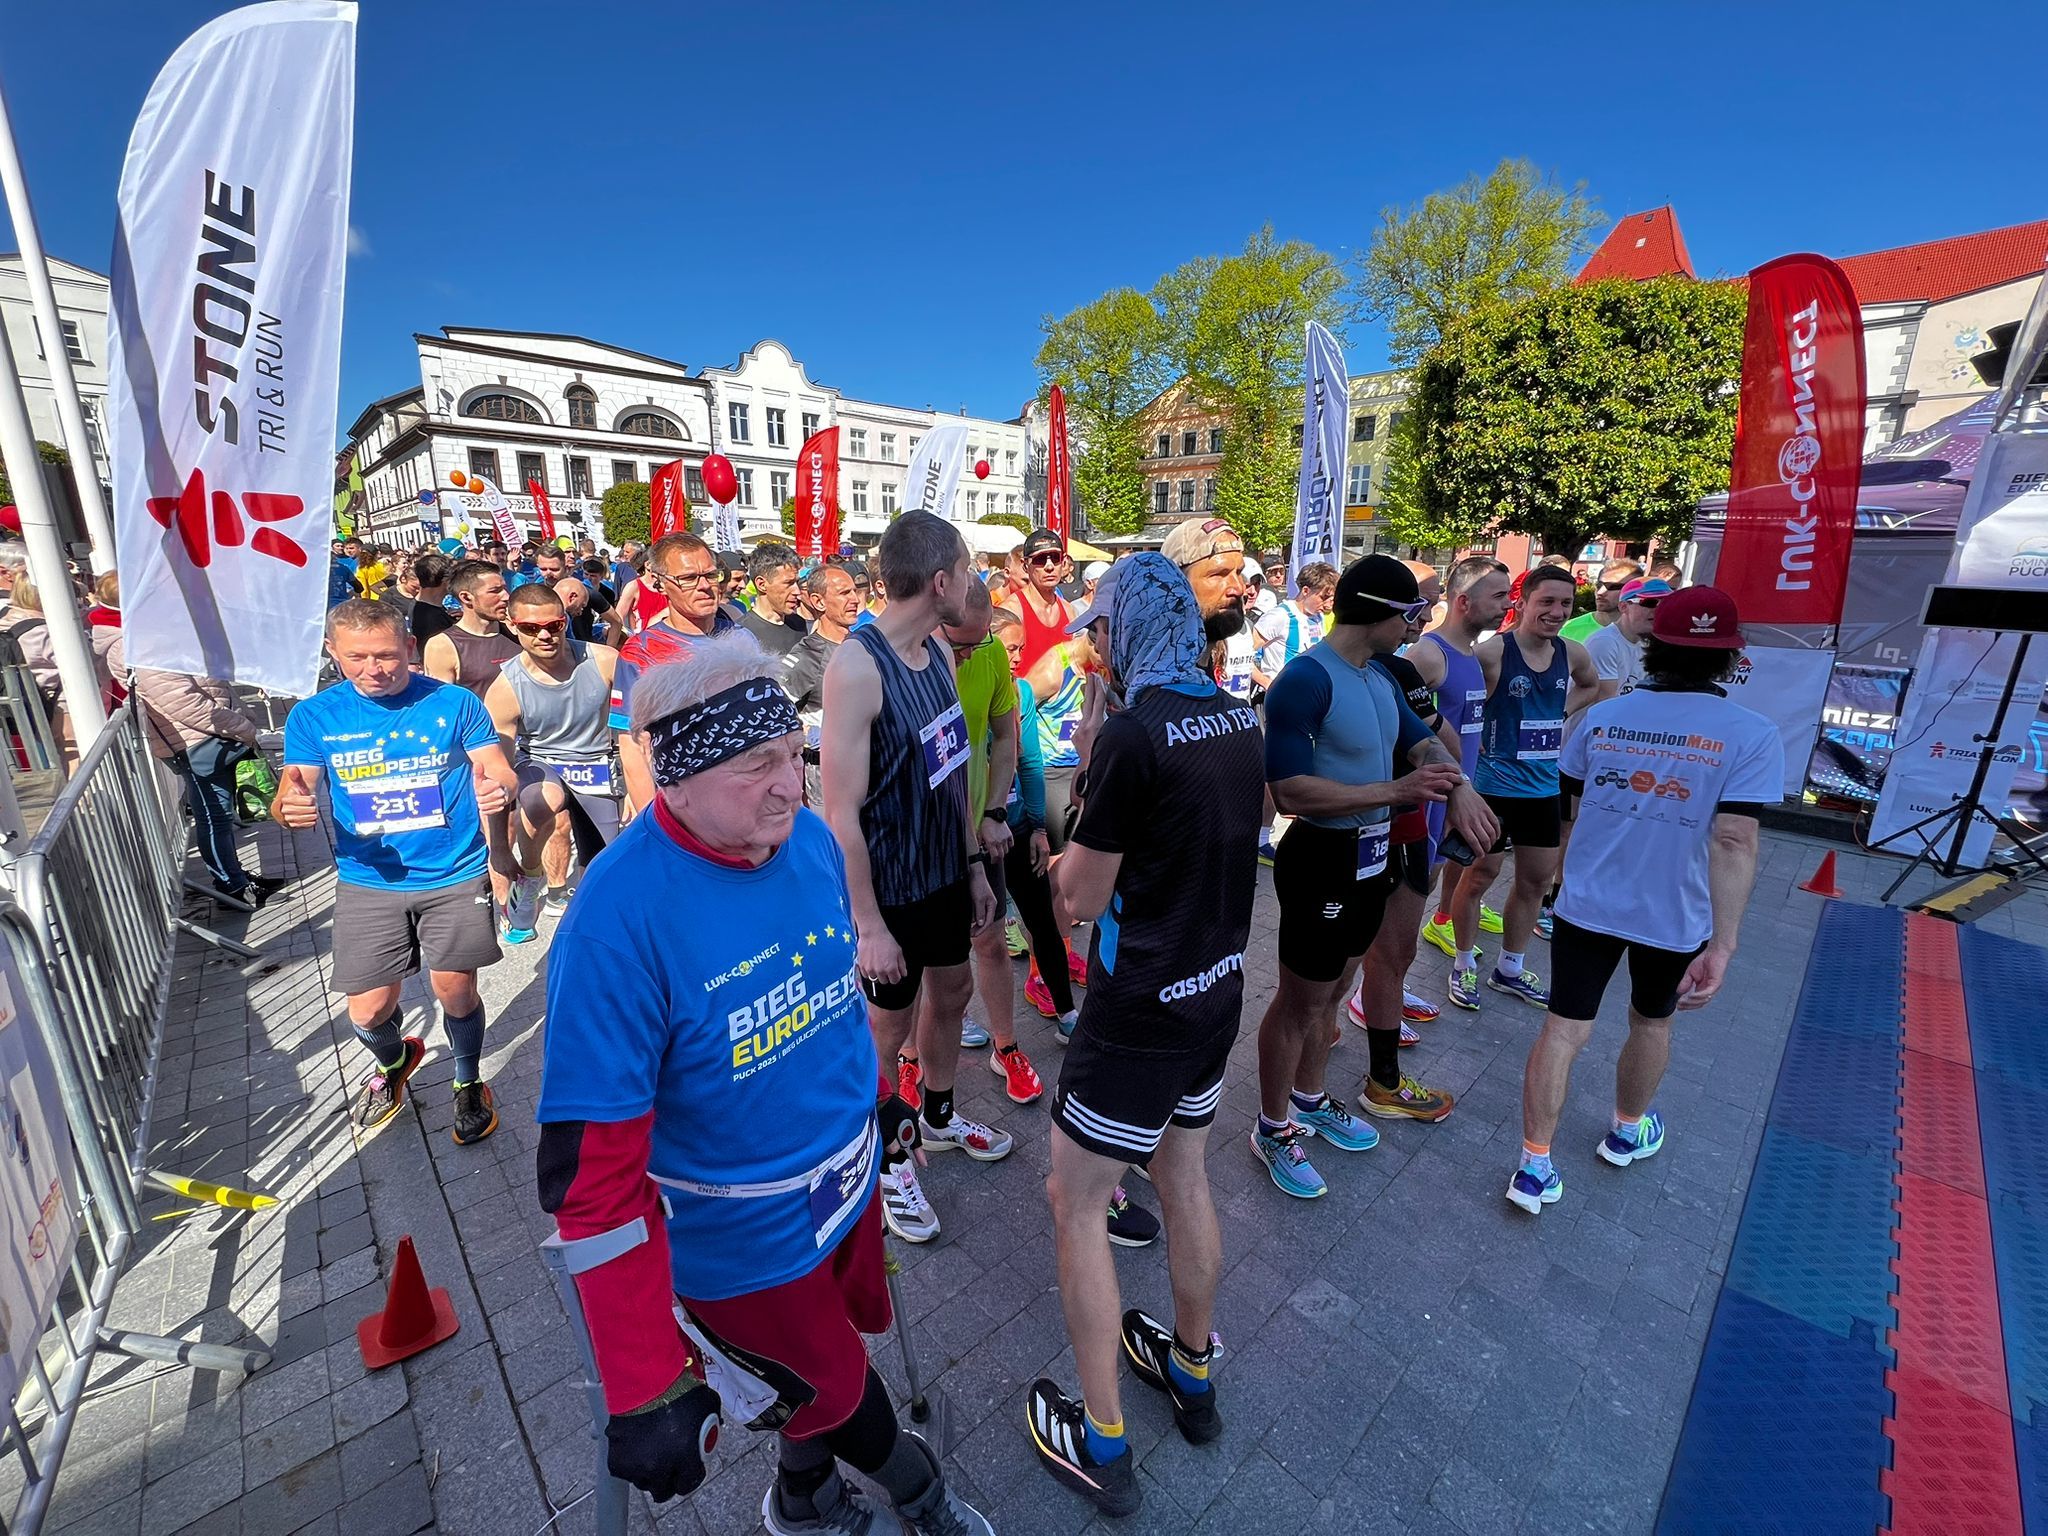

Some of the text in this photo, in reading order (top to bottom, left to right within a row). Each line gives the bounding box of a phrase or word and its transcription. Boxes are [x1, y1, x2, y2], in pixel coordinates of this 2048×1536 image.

[192, 168, 256, 446] STONE
[255, 311, 286, 454] TRI & RUN
[921, 458, 942, 511] TONE
[745, 684, 784, 702] Liv
[1165, 712, 1233, 747] AGATA
[1822, 706, 1896, 730] nicz
[1541, 734, 1547, 746] 1
[1607, 725, 1725, 754] ChampionMan
[1825, 728, 1894, 751] zap
[331, 747, 384, 768] BIEG
[336, 752, 450, 782] EUROPEJSKI
[1625, 746, 1722, 768] DUATHLONU
[564, 770, 592, 782] 100
[375, 797, 415, 815] 231
[1374, 840, 1389, 857] 18
[704, 942, 781, 992] LUK-CONNECT
[727, 971, 807, 1042] BIEG
[733, 1066, 757, 1082] PUCK
[757, 1055, 777, 1070] 2025
[781, 1040, 796, 1057] BIEG
[795, 1022, 821, 1046] ULICZNY
[821, 1016, 831, 1028] NA
[832, 1010, 840, 1020] 10
[697, 1186, 731, 1196] ENERGY
